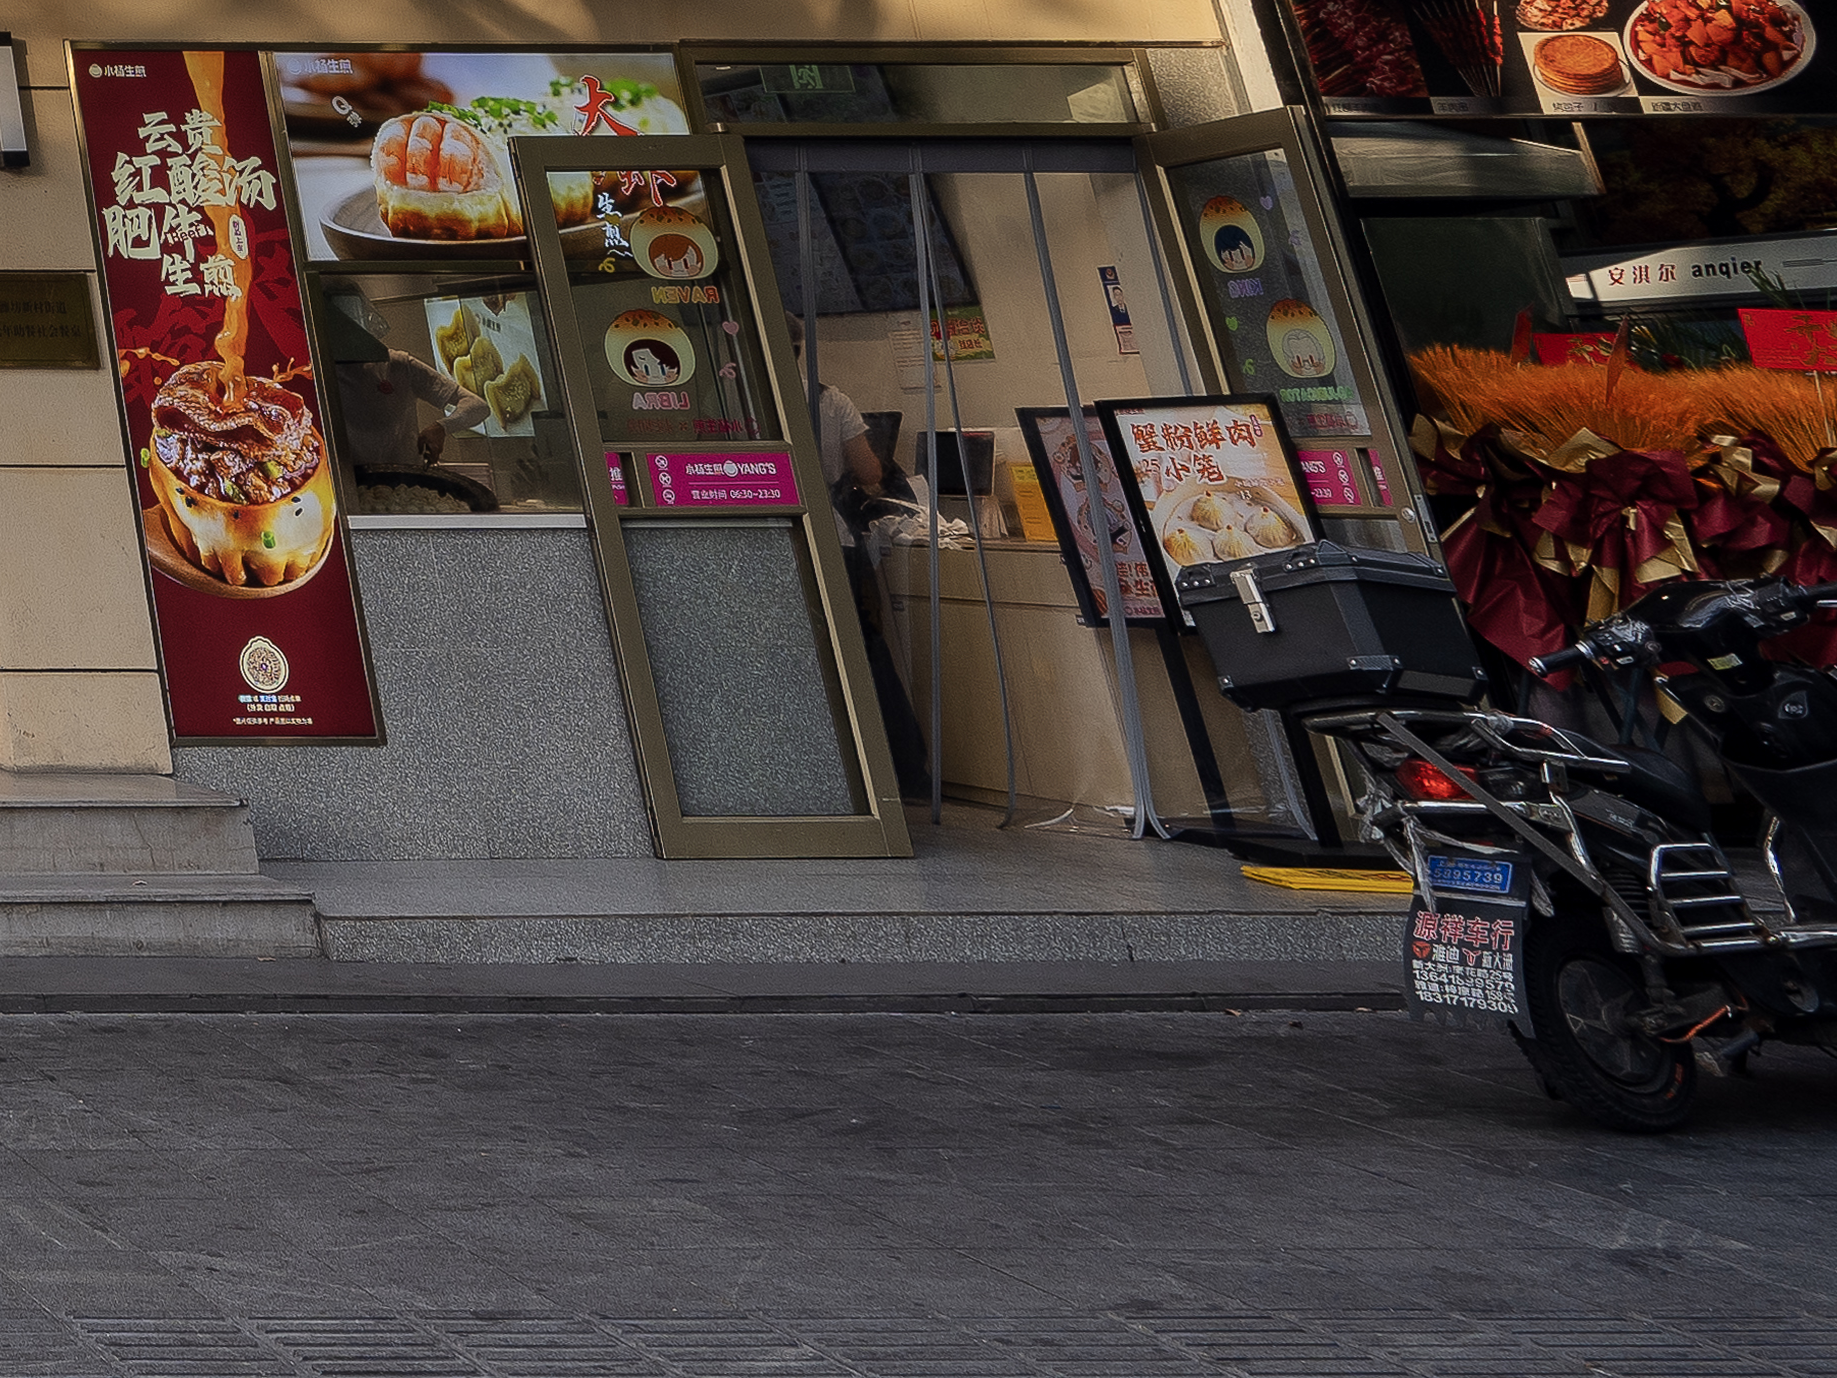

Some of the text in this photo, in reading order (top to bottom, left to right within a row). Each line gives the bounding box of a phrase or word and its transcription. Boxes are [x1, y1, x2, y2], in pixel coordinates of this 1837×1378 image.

[104, 64, 147, 78] 小杨生煎
[137, 108, 224, 155] 云贵
[110, 151, 277, 211] 红酸汤
[101, 202, 214, 264] 肥牛
[160, 253, 243, 302] 生煎
[1608, 262, 1677, 286] 安淇尔
[1690, 256, 1763, 281] anqier
[1129, 418, 1258, 454] 蟹粉鲜肉
[1412, 909, 1515, 951] 源祥车行
